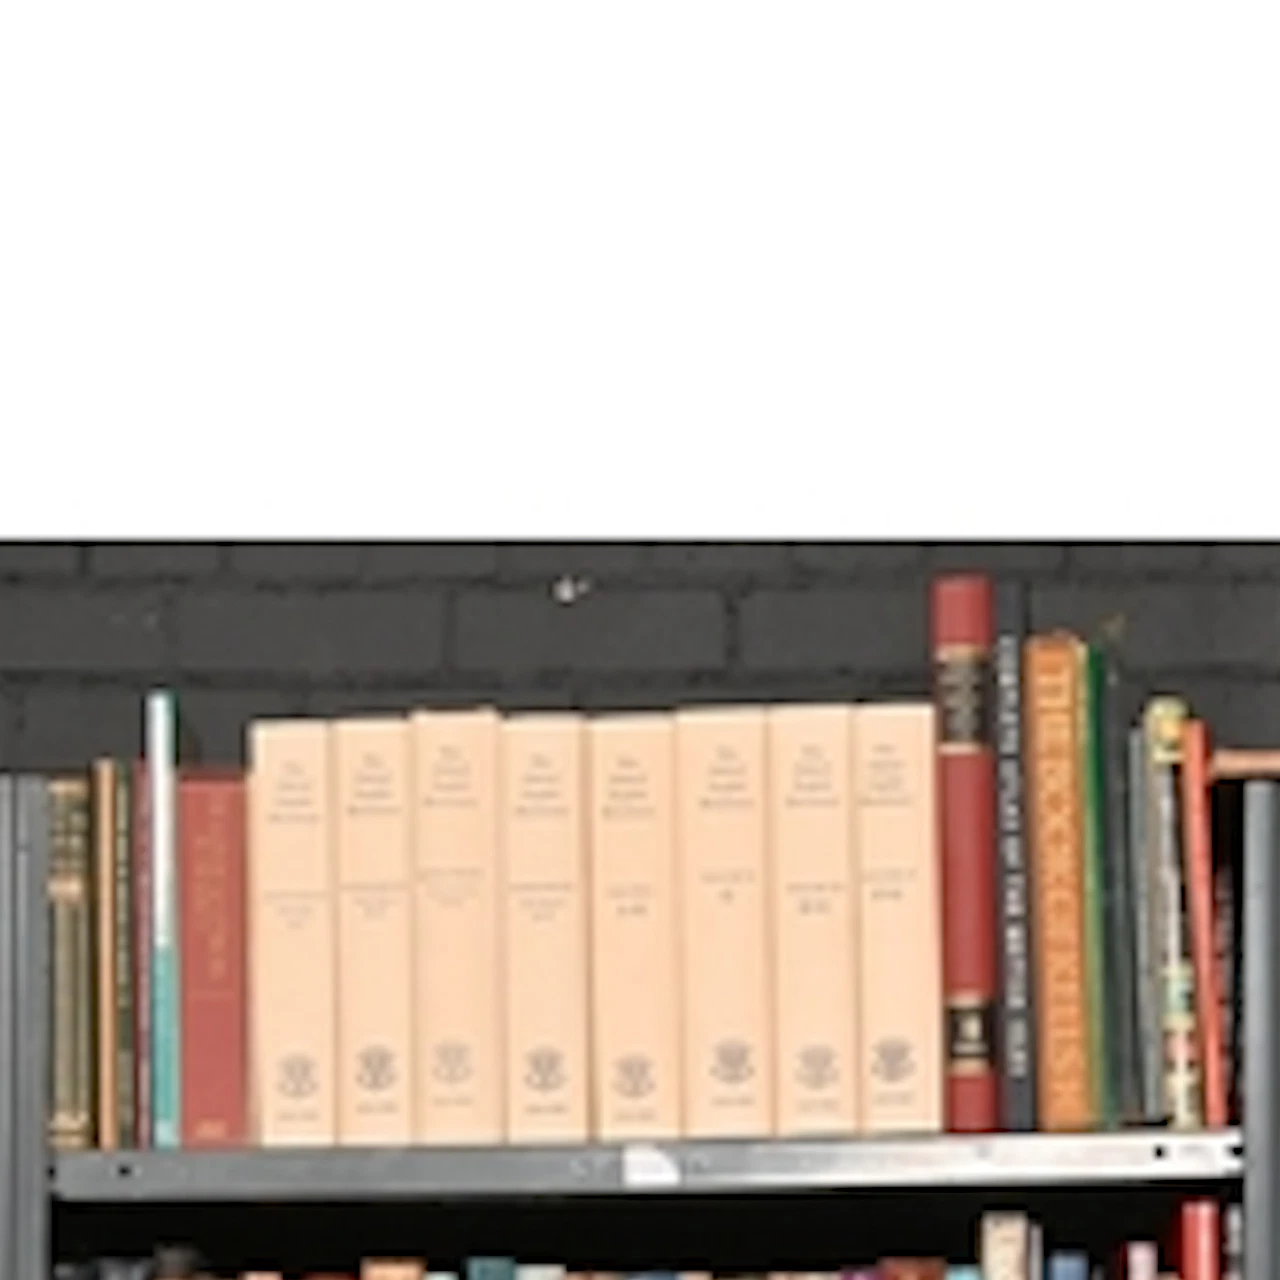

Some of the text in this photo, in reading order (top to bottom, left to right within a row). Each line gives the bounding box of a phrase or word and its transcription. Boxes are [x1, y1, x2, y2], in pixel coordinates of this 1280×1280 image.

[1035, 667, 1073, 752] THE
[1037, 758, 1076, 885] BOOK
[1045, 949, 1083, 1075] KELLS
